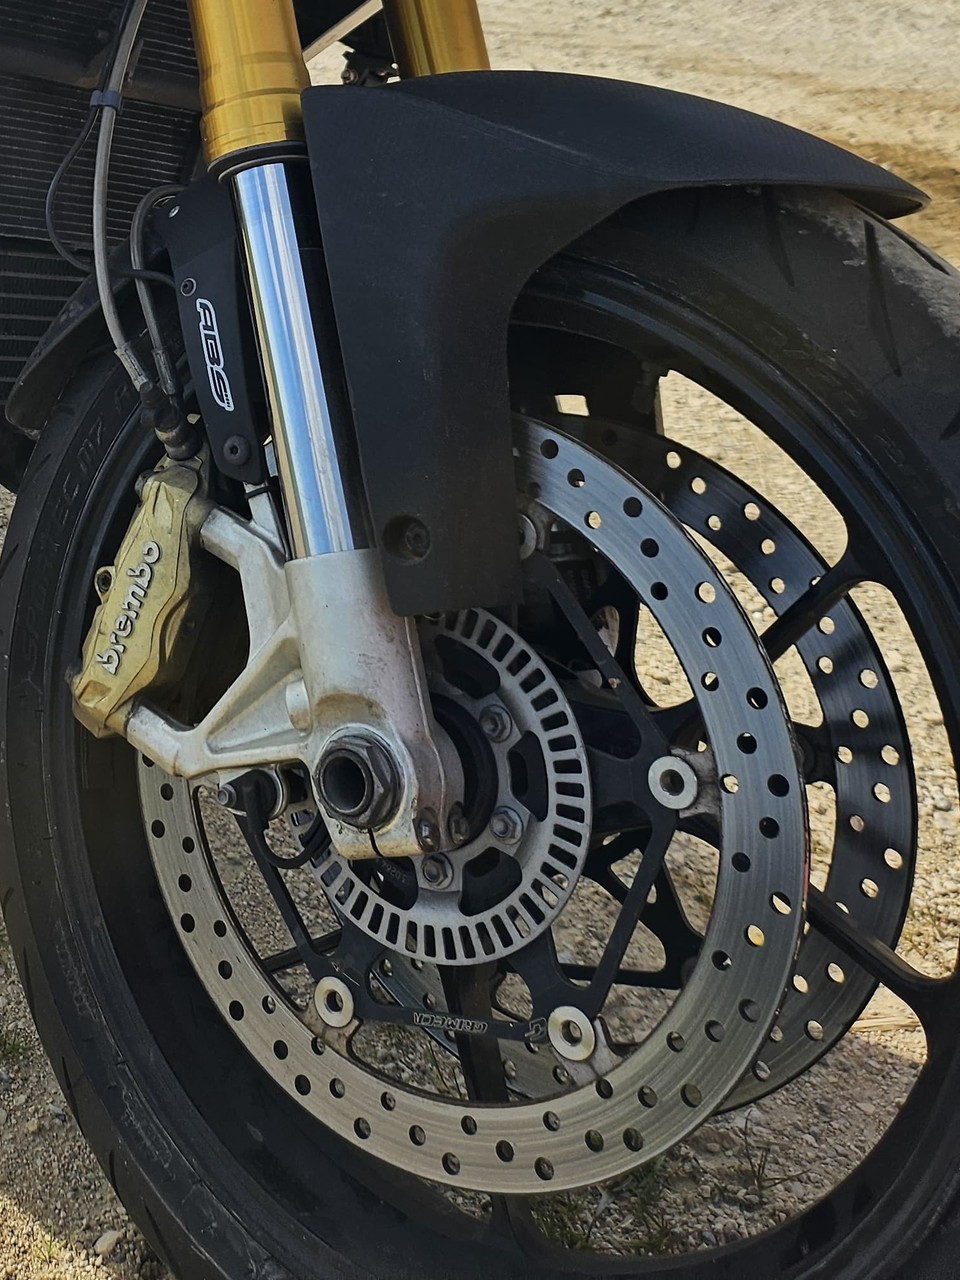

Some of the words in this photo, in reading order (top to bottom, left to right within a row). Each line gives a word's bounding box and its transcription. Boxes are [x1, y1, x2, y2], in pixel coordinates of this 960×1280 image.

[195, 297, 235, 412] ABS
[95, 540, 161, 676] brembo
[412, 1011, 489, 1034] GRIMECA
